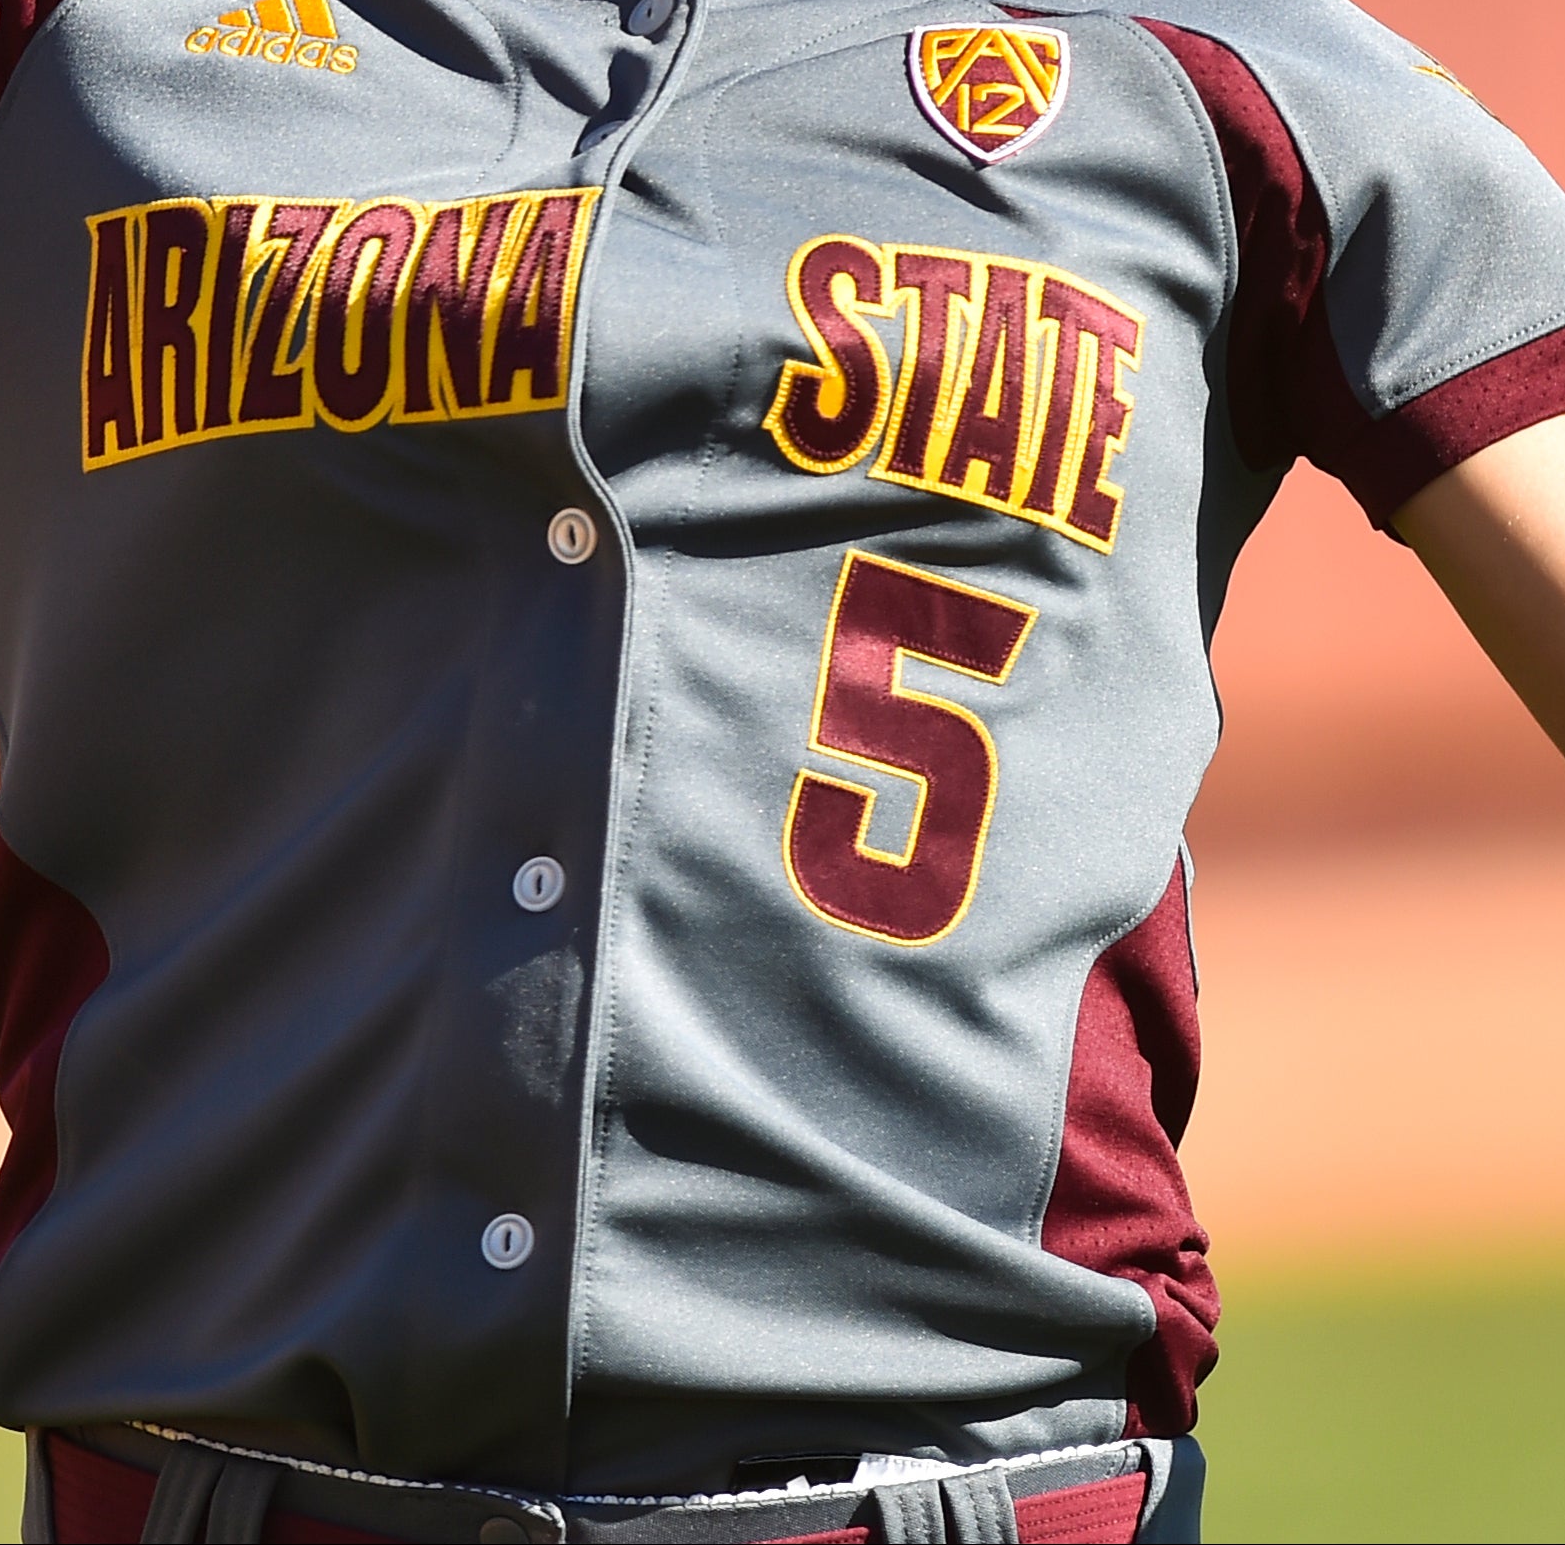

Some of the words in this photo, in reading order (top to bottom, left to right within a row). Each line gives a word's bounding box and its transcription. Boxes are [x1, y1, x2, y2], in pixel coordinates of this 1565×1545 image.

[185, 25, 360, 75] adidas
[921, 27, 1062, 116] PAC
[956, 81, 1026, 136] 12
[83, 186, 604, 473] ARIZONA
[762, 232, 1148, 556] STATE
[782, 547, 1041, 948] 5
